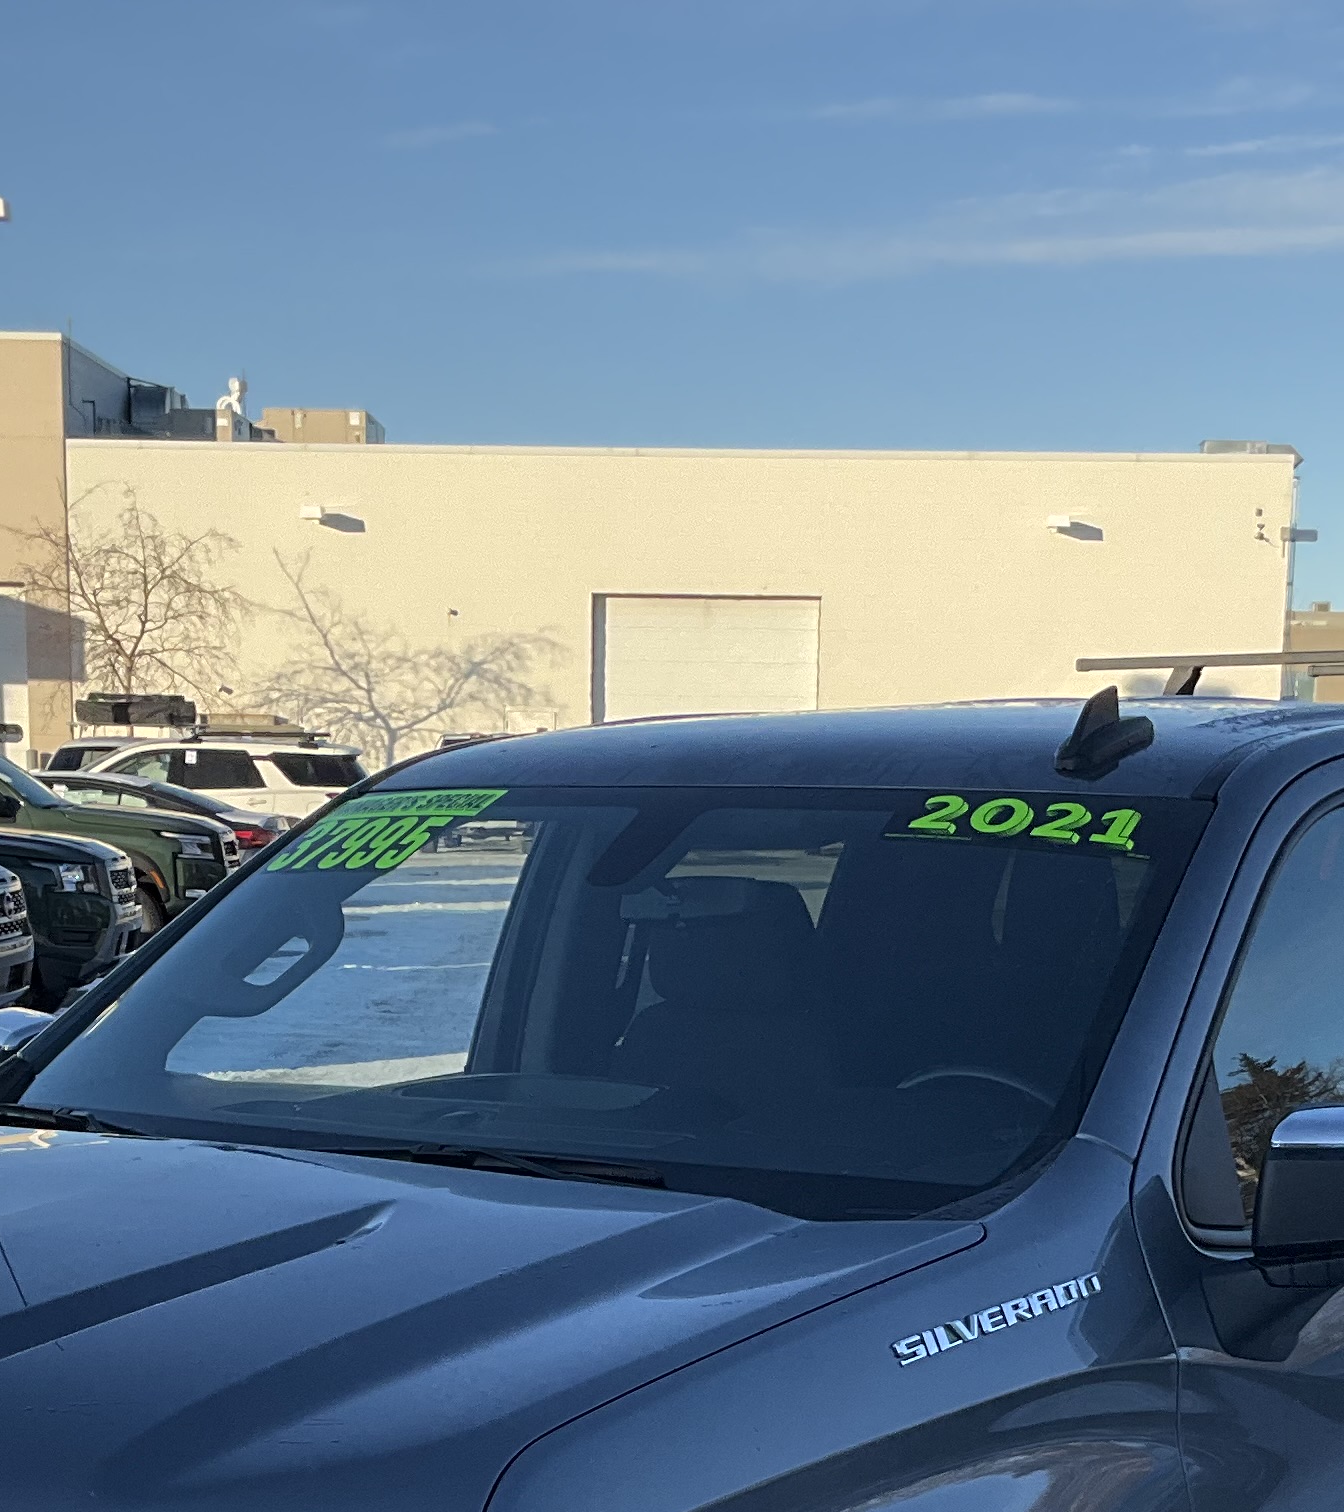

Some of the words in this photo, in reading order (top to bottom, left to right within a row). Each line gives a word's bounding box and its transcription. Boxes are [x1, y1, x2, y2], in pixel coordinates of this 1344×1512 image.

[414, 791, 497, 811] SPECIAL
[908, 794, 1143, 851] 2021
[266, 815, 454, 872] 37995
[891, 1271, 1102, 1367] SILVERADO
